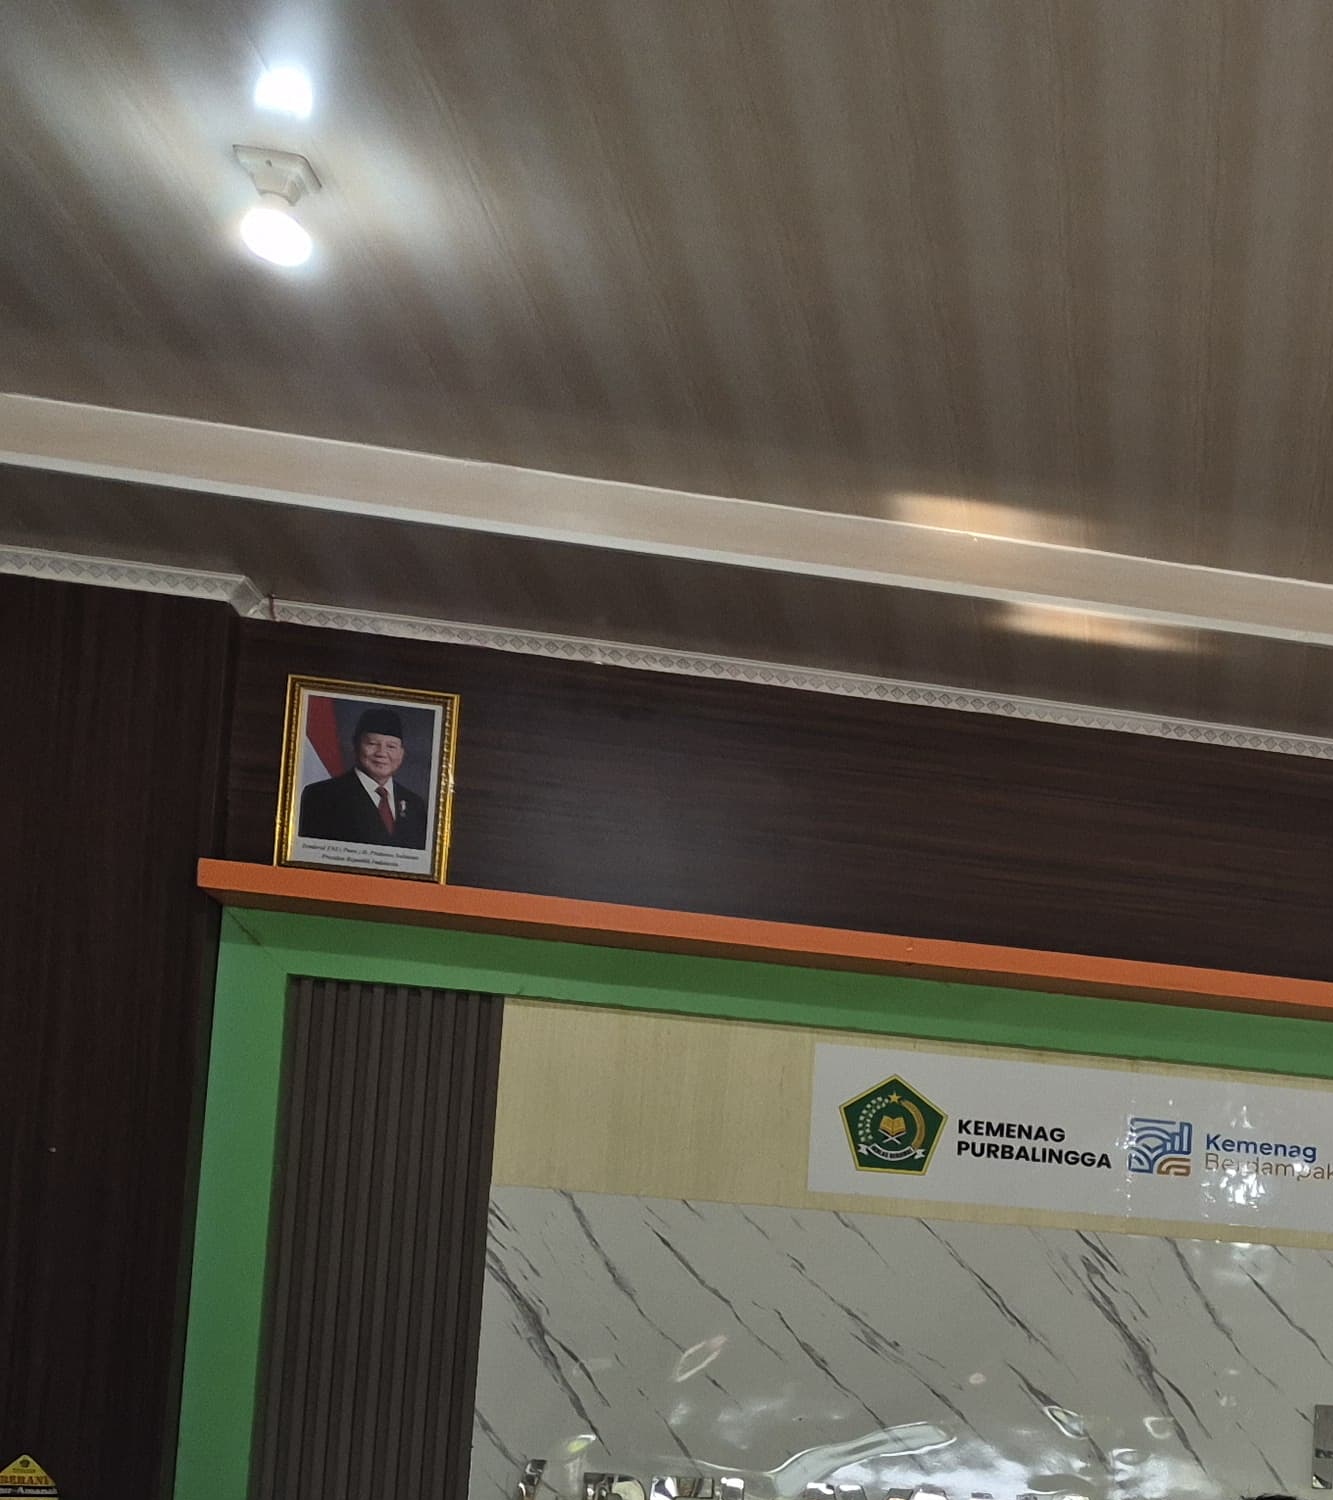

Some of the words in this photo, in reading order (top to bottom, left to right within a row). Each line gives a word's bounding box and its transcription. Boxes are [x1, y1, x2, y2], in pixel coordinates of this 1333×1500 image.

[957, 1119, 1066, 1143] KEMENAG
[956, 1141, 1112, 1170] PURBALINGGA
[1205, 1133, 1318, 1163] Kemenag
